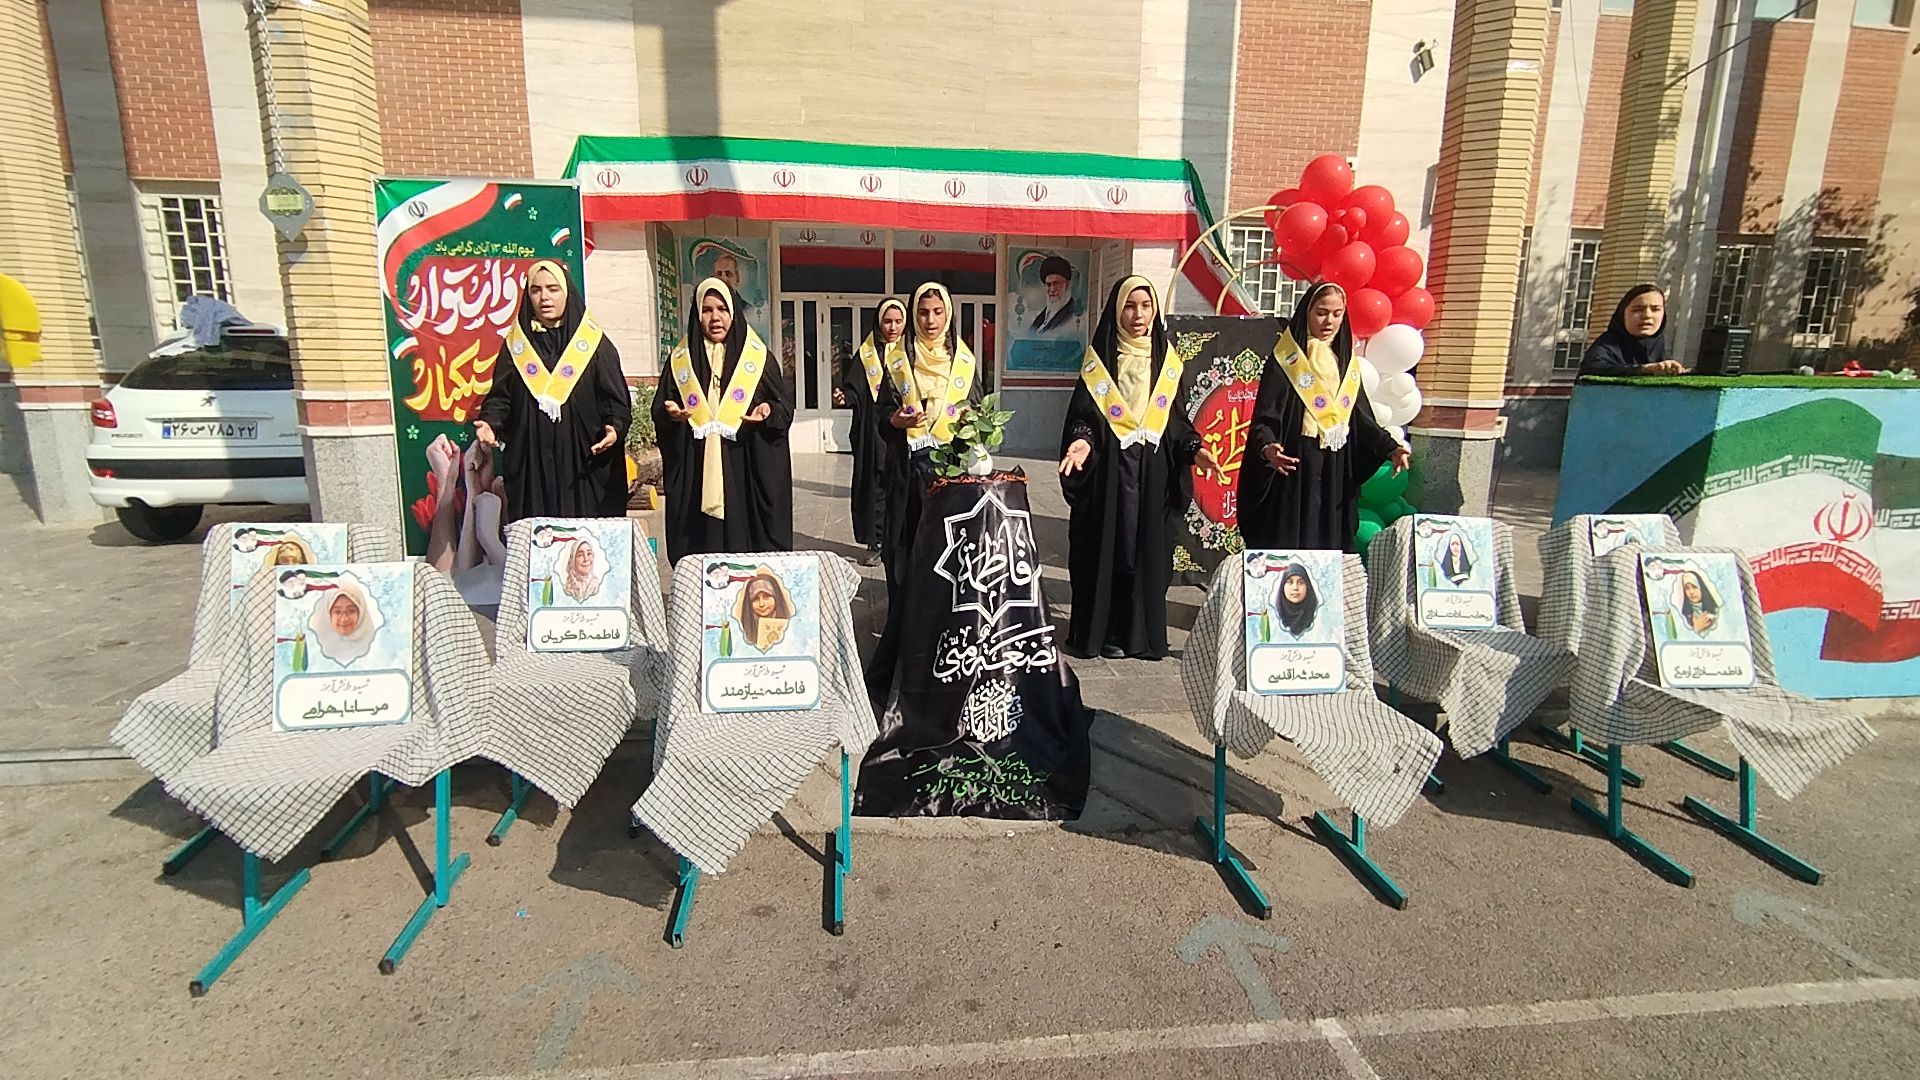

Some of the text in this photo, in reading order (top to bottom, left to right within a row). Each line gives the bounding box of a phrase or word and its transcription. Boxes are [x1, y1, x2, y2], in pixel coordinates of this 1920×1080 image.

[435, 240, 448, 255] باد
[447, 240, 473, 257] گرامی
[502, 242, 518, 253] الله
[587, 628, 620, 640] فاطمه
[720, 680, 806, 700] فاطمه نیازمند
